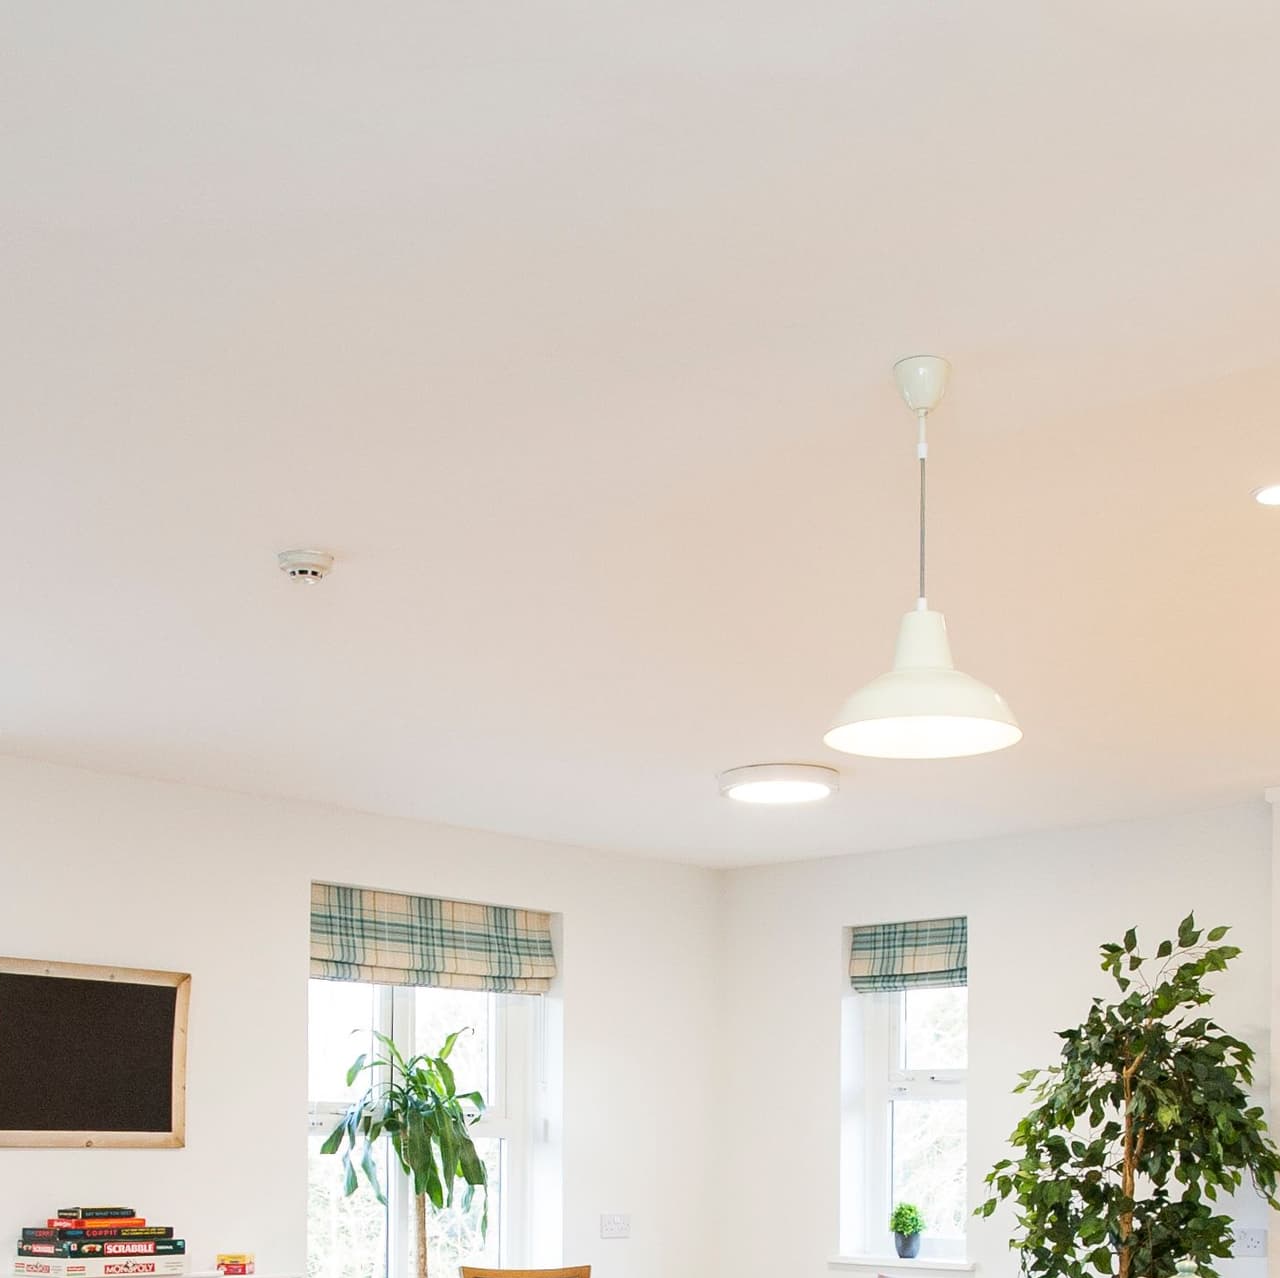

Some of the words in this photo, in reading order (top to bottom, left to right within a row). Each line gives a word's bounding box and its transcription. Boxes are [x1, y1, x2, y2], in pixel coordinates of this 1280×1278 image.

[86, 1229, 118, 1237] COPPIT
[106, 1243, 155, 1254] SCRABBLE
[105, 1262, 154, 1274] MONOPOLY
